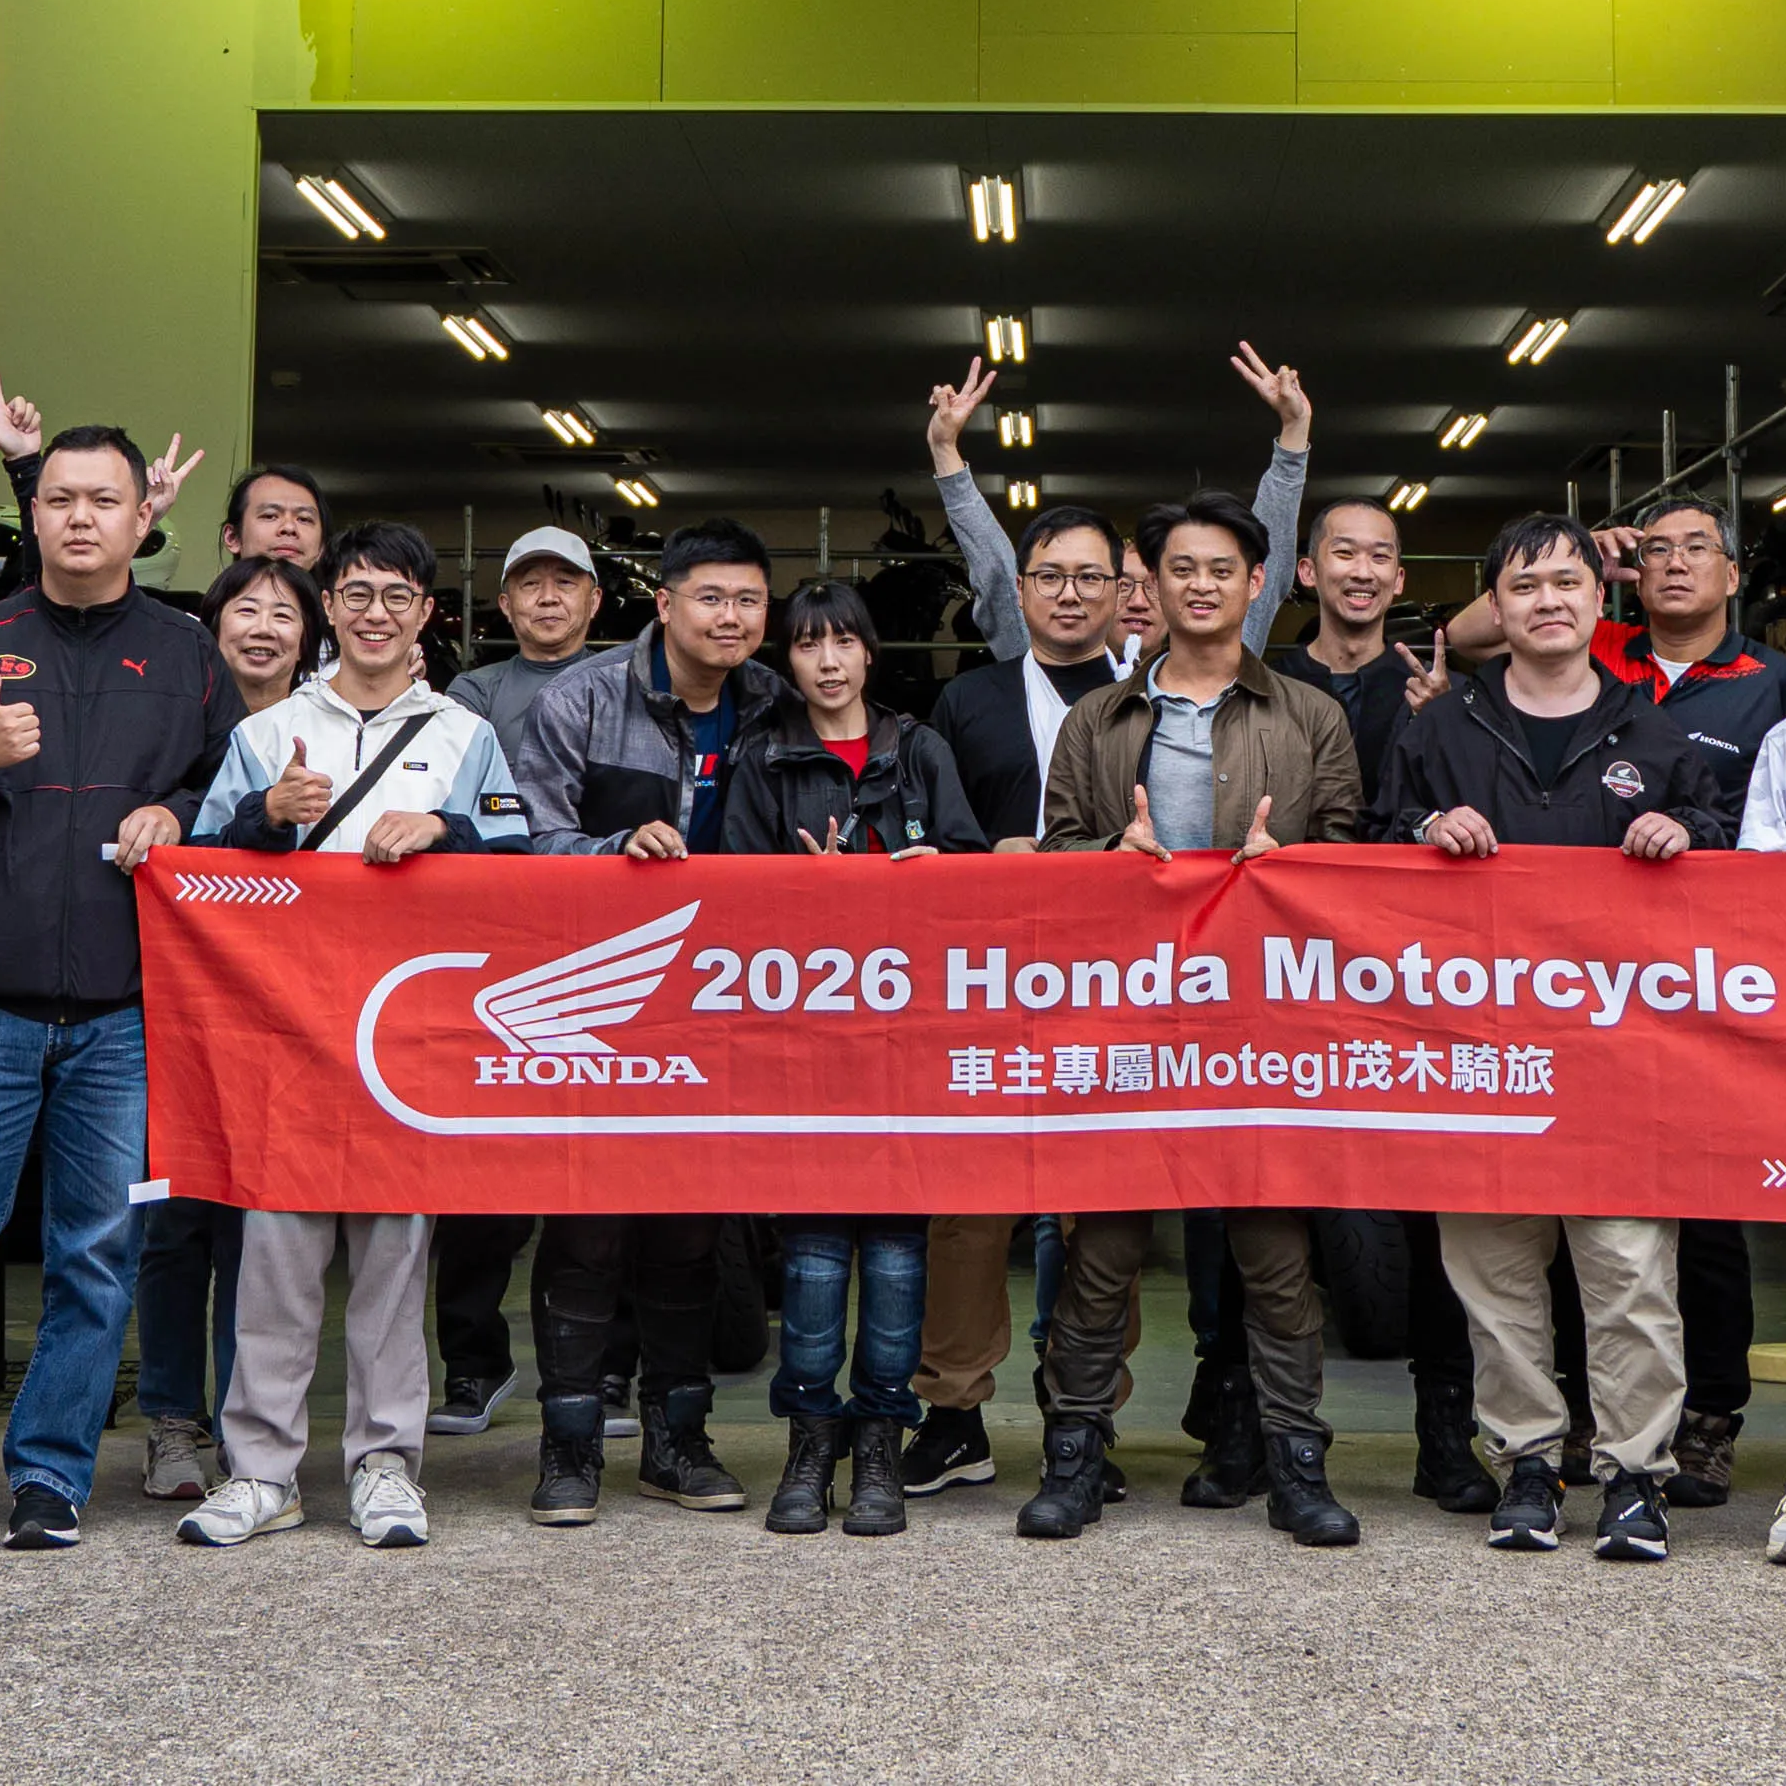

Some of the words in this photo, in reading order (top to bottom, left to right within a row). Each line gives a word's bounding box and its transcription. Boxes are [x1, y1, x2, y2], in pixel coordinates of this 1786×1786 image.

[1699, 735, 1741, 754] HONDA
[691, 947, 913, 1012] 2026
[946, 941, 1231, 1011] Honda
[1264, 935, 1777, 1027] Motorcycle
[474, 1055, 709, 1085] HONDA
[947, 1039, 1555, 1099] 車主專屬Motegi茂木騎旅
